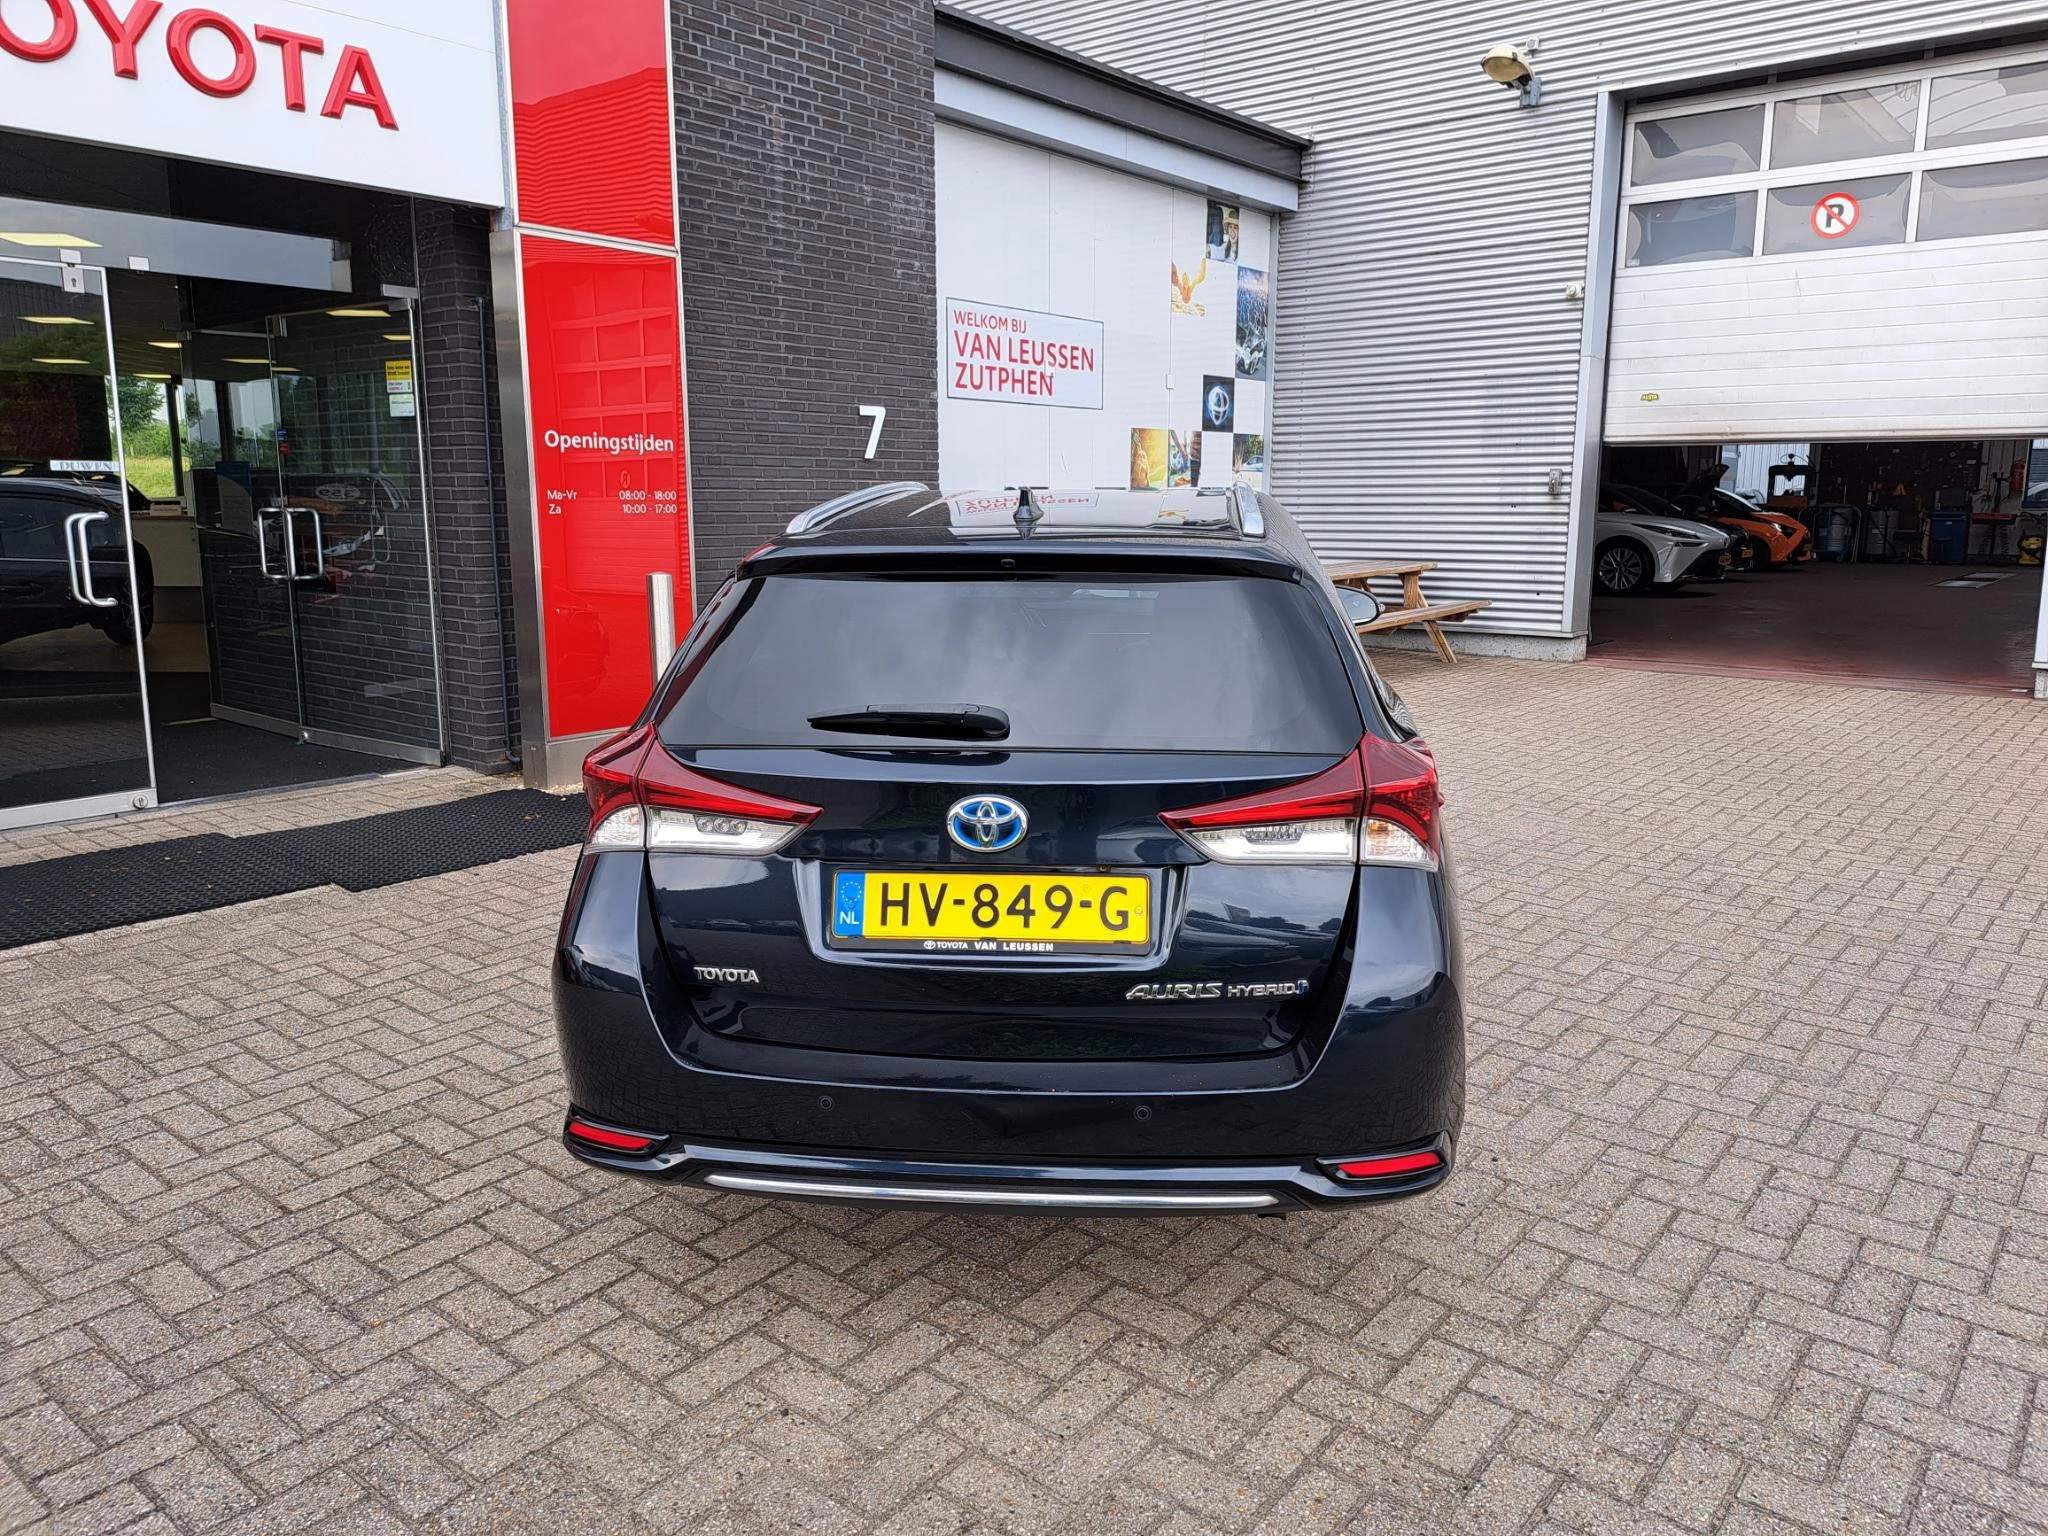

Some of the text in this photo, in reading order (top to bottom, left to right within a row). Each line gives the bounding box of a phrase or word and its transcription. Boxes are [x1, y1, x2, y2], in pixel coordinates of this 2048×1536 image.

[953, 309, 1027, 334] WELKOM BIJ
[954, 329, 1094, 372] VAN LEUSSEN
[955, 362, 1054, 396] ZUTPHEN
[859, 405, 886, 459] 7
[544, 429, 674, 456] Openingstijden
[60, 461, 113, 471] DUWEN
[547, 489, 577, 500] Ma-Vr
[619, 490, 646, 500] 08:00
[654, 490, 677, 500] 18:00
[548, 504, 562, 514] Za
[622, 503, 647, 514] 10:00
[654, 503, 677, 514] 17:00
[880, 882, 1130, 931] HV-849-G
[840, 911, 860, 925] NL
[937, 940, 1054, 952] TOYOTA VAN LEUSSEN
[693, 966, 760, 983] TOYOTA
[1126, 982, 1297, 1001] AURIS HYBRID
